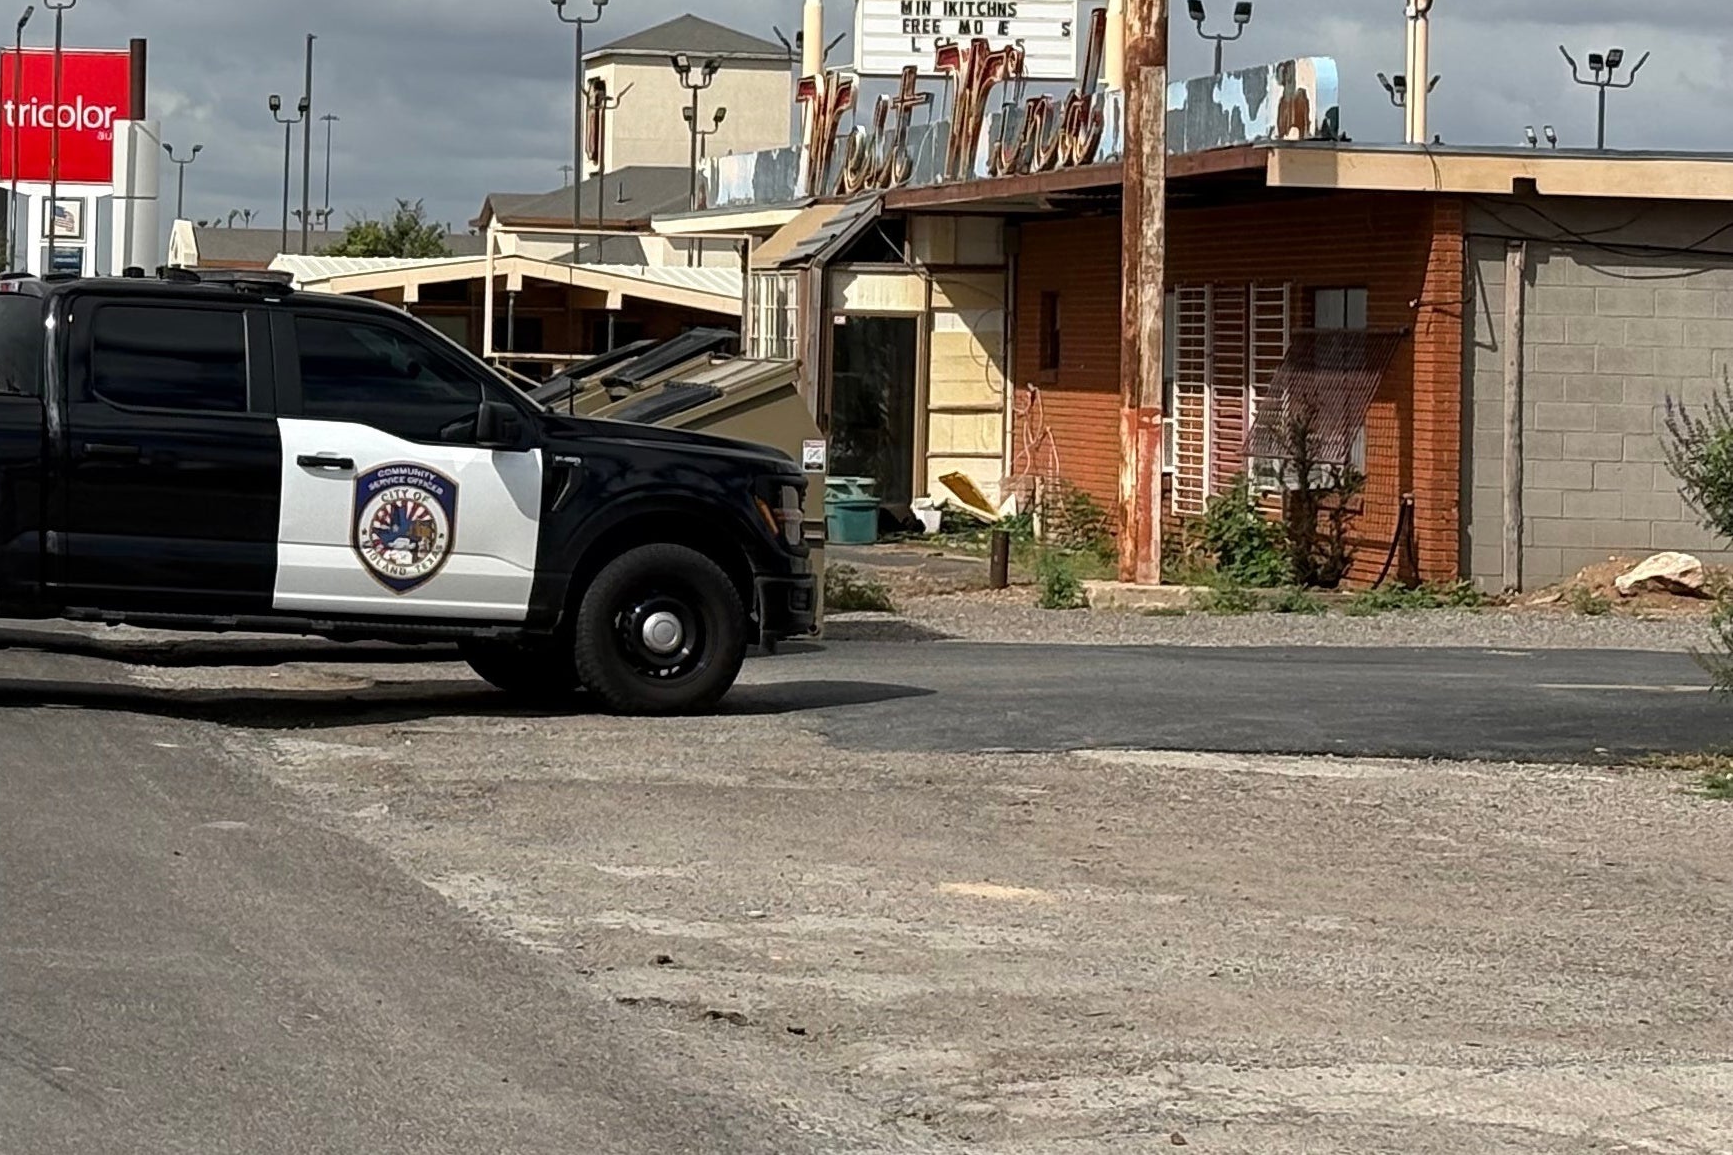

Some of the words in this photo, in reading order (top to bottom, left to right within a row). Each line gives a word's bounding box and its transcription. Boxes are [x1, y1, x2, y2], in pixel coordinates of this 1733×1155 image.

[900, 0, 932, 16] MIN
[902, 18, 941, 35] FREE
[3, 95, 117, 131] tricolor
[377, 466, 437, 480] COMMUNITY
[368, 476, 406, 491] SERVICE
[407, 476, 444, 495] OFFICER
[381, 488, 409, 502] CITY
[413, 491, 430, 502] OF
[415, 544, 444, 574] TEXAS
